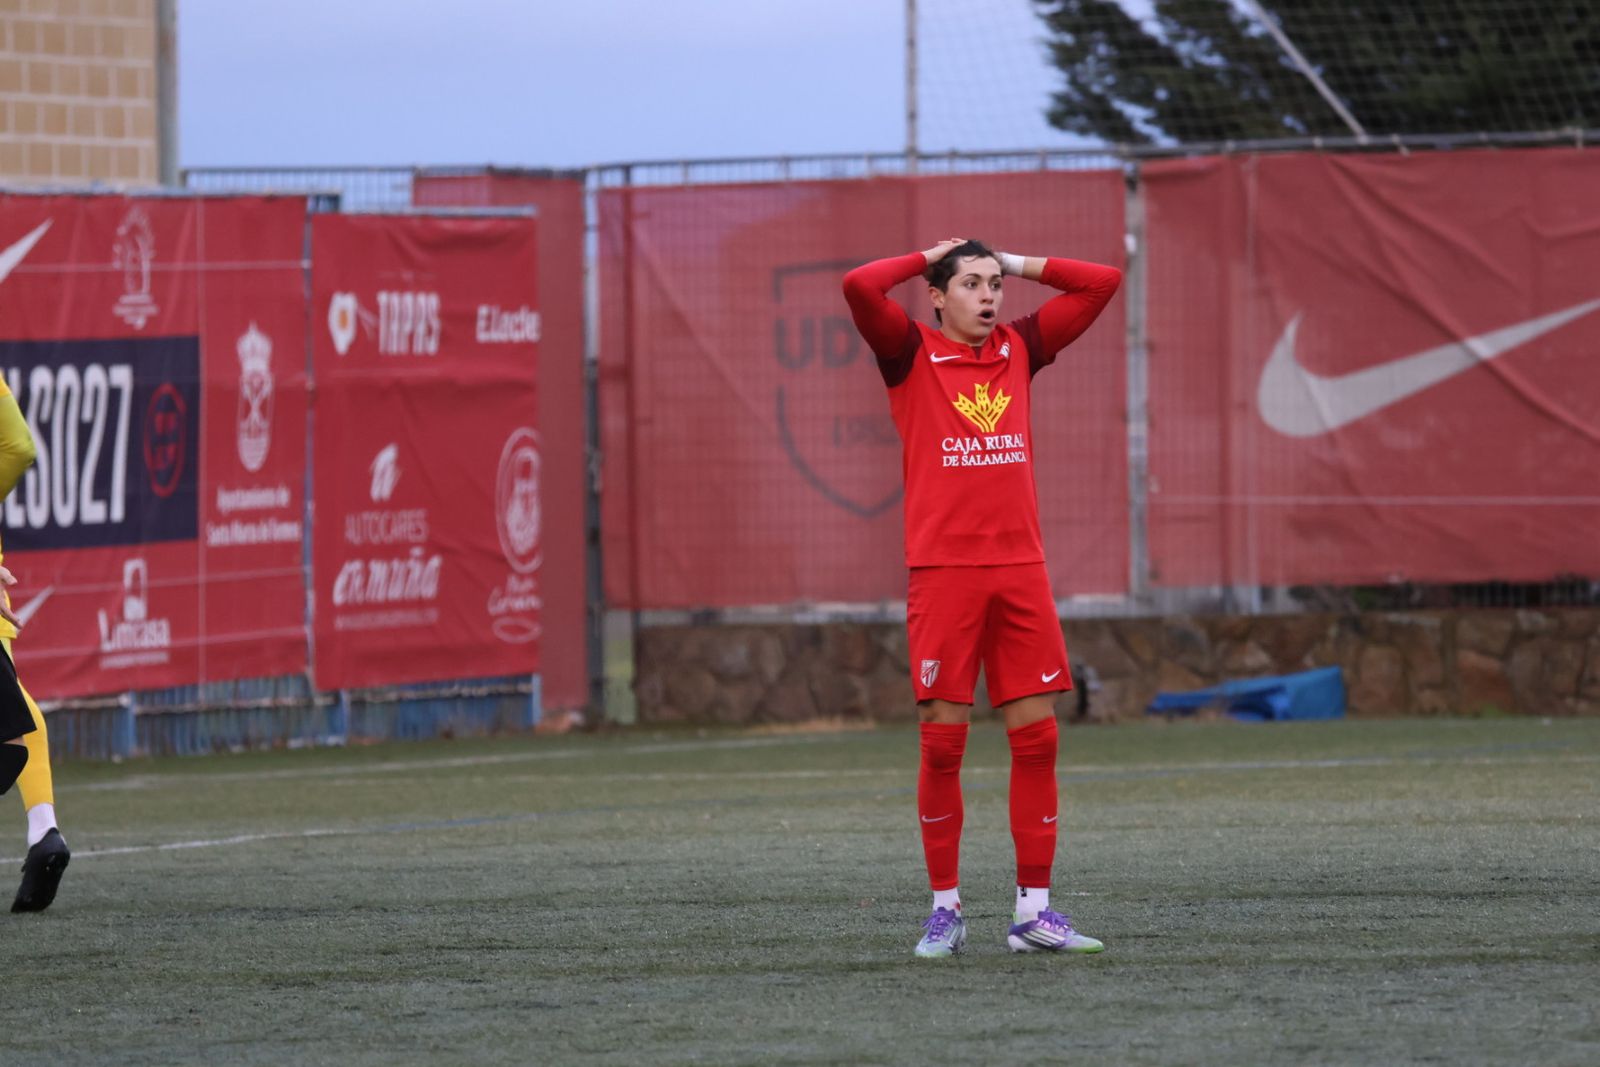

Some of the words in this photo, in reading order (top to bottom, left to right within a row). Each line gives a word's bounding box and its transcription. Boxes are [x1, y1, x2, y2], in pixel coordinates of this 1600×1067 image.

[773, 316, 873, 369] UD
[942, 437, 982, 455] CAJA
[984, 433, 1025, 450] RURAL
[943, 455, 959, 467] DE
[961, 452, 1026, 466] SALAMANCA
